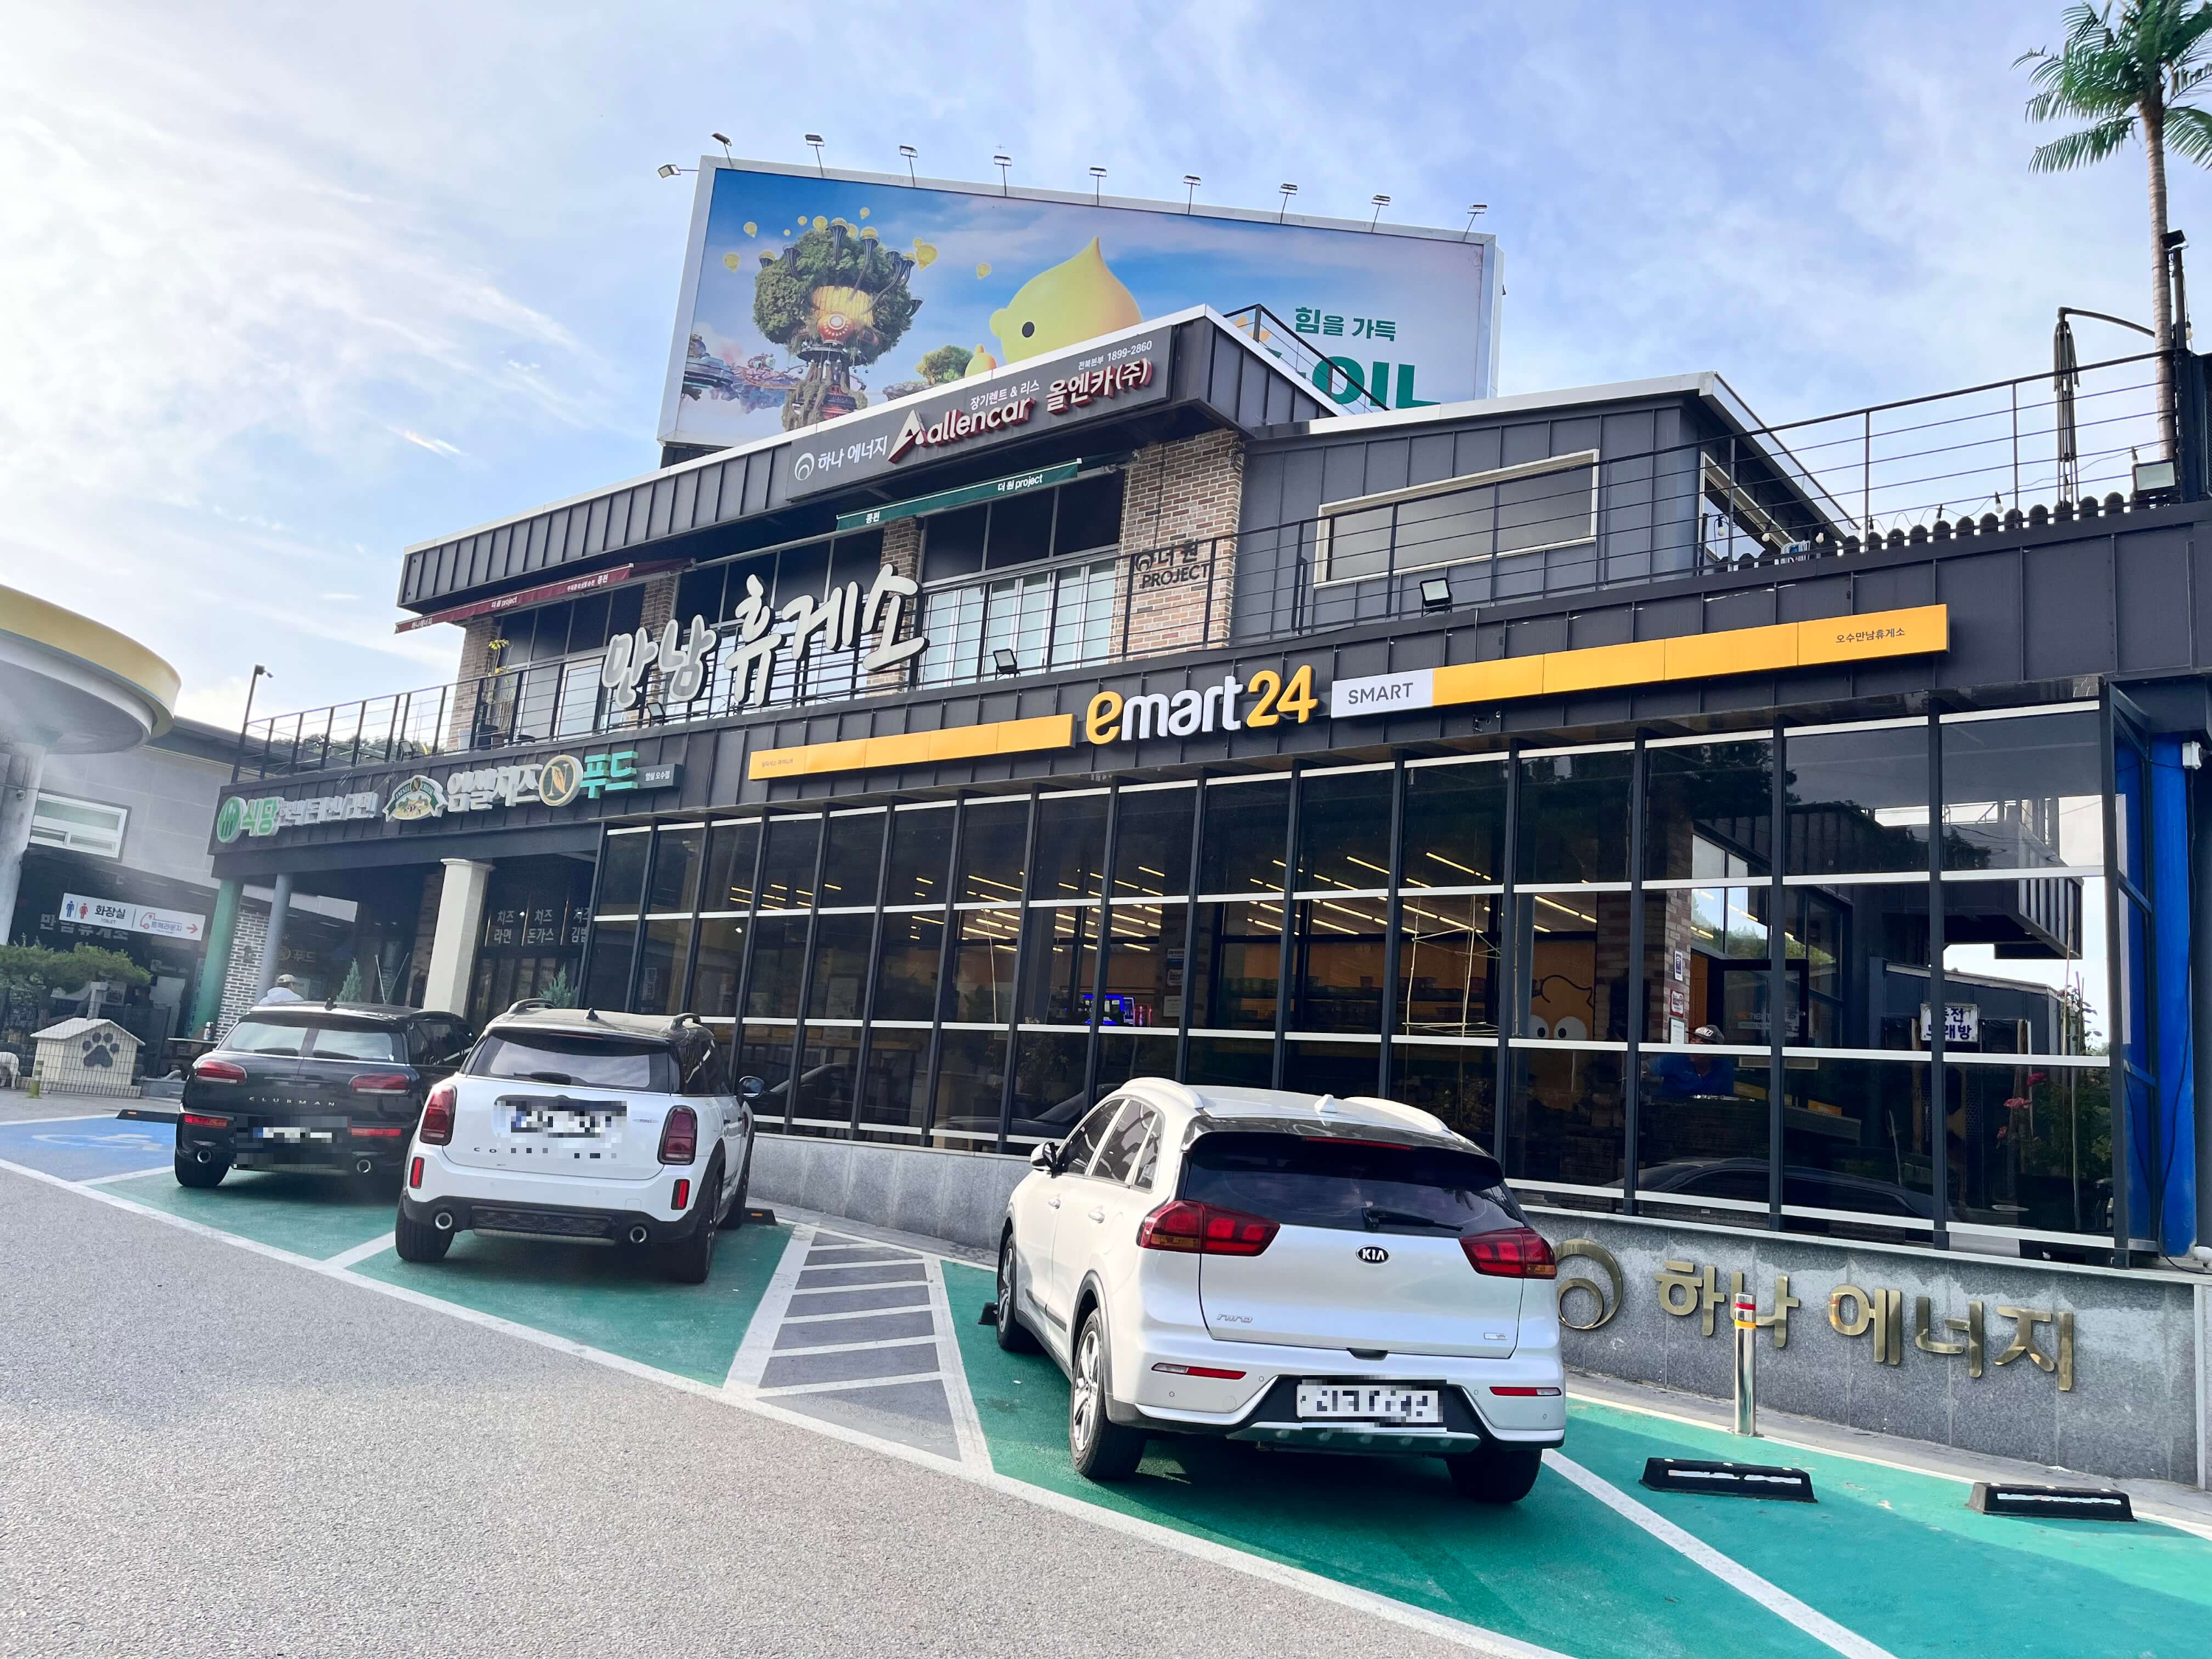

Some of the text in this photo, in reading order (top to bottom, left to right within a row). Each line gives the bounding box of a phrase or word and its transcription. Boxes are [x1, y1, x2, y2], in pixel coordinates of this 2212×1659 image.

[1295, 307, 1396, 341] 힘을 가득
[1078, 340, 1152, 371] 전북본부 1899-2860
[970, 381, 1040, 410] 장기렌트 & 리스
[818, 435, 888, 472] 하나 에너지
[1015, 474, 1043, 490] project
[1143, 563, 1211, 588] PROJECT
[1835, 627, 1905, 644] 오수만남휴게소
[1085, 664, 1414, 745] emart24 SMART
[446, 764, 543, 813] 임실치즈
[580, 751, 639, 799] 푸드
[240, 796, 279, 836] 식당
[94, 905, 126, 919] 화장실
[497, 910, 515, 925] 치즈
[535, 908, 553, 925] 치즈
[493, 928, 512, 945] 라면
[526, 928, 554, 944] 돈가스
[249, 1096, 335, 1107] CLUBMAN
[1362, 1248, 1385, 1261] KIA
[1655, 1259, 2074, 1391] 하나 에너지
